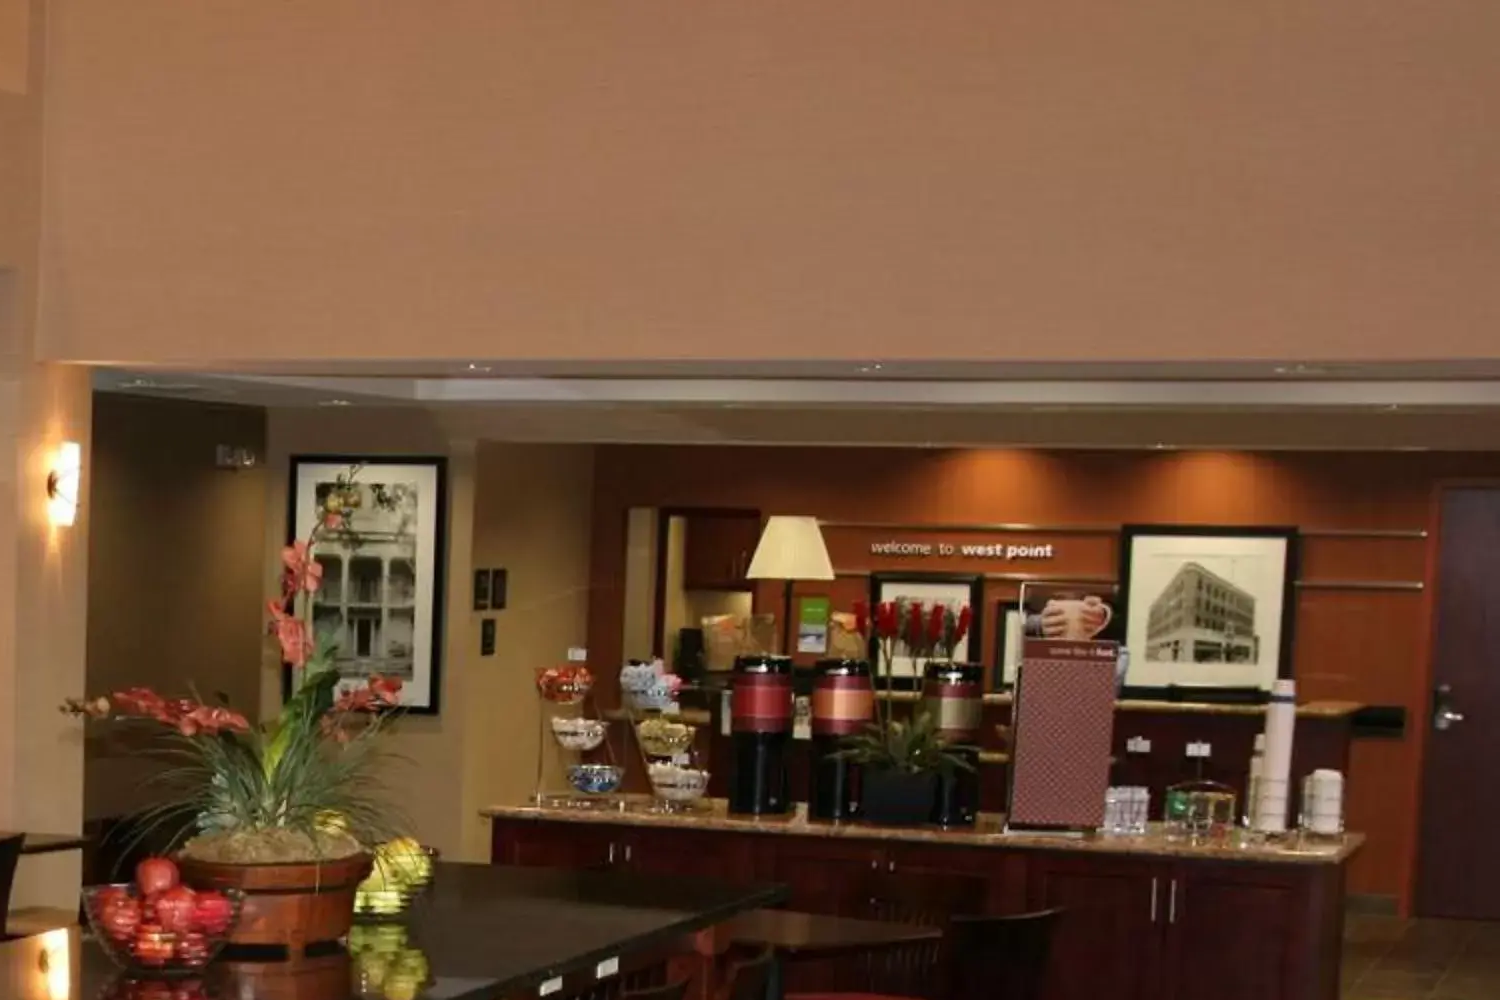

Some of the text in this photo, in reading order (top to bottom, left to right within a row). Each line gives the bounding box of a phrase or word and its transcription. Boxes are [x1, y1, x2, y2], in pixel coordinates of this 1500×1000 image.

[871, 540, 1053, 561] welcome to west point
